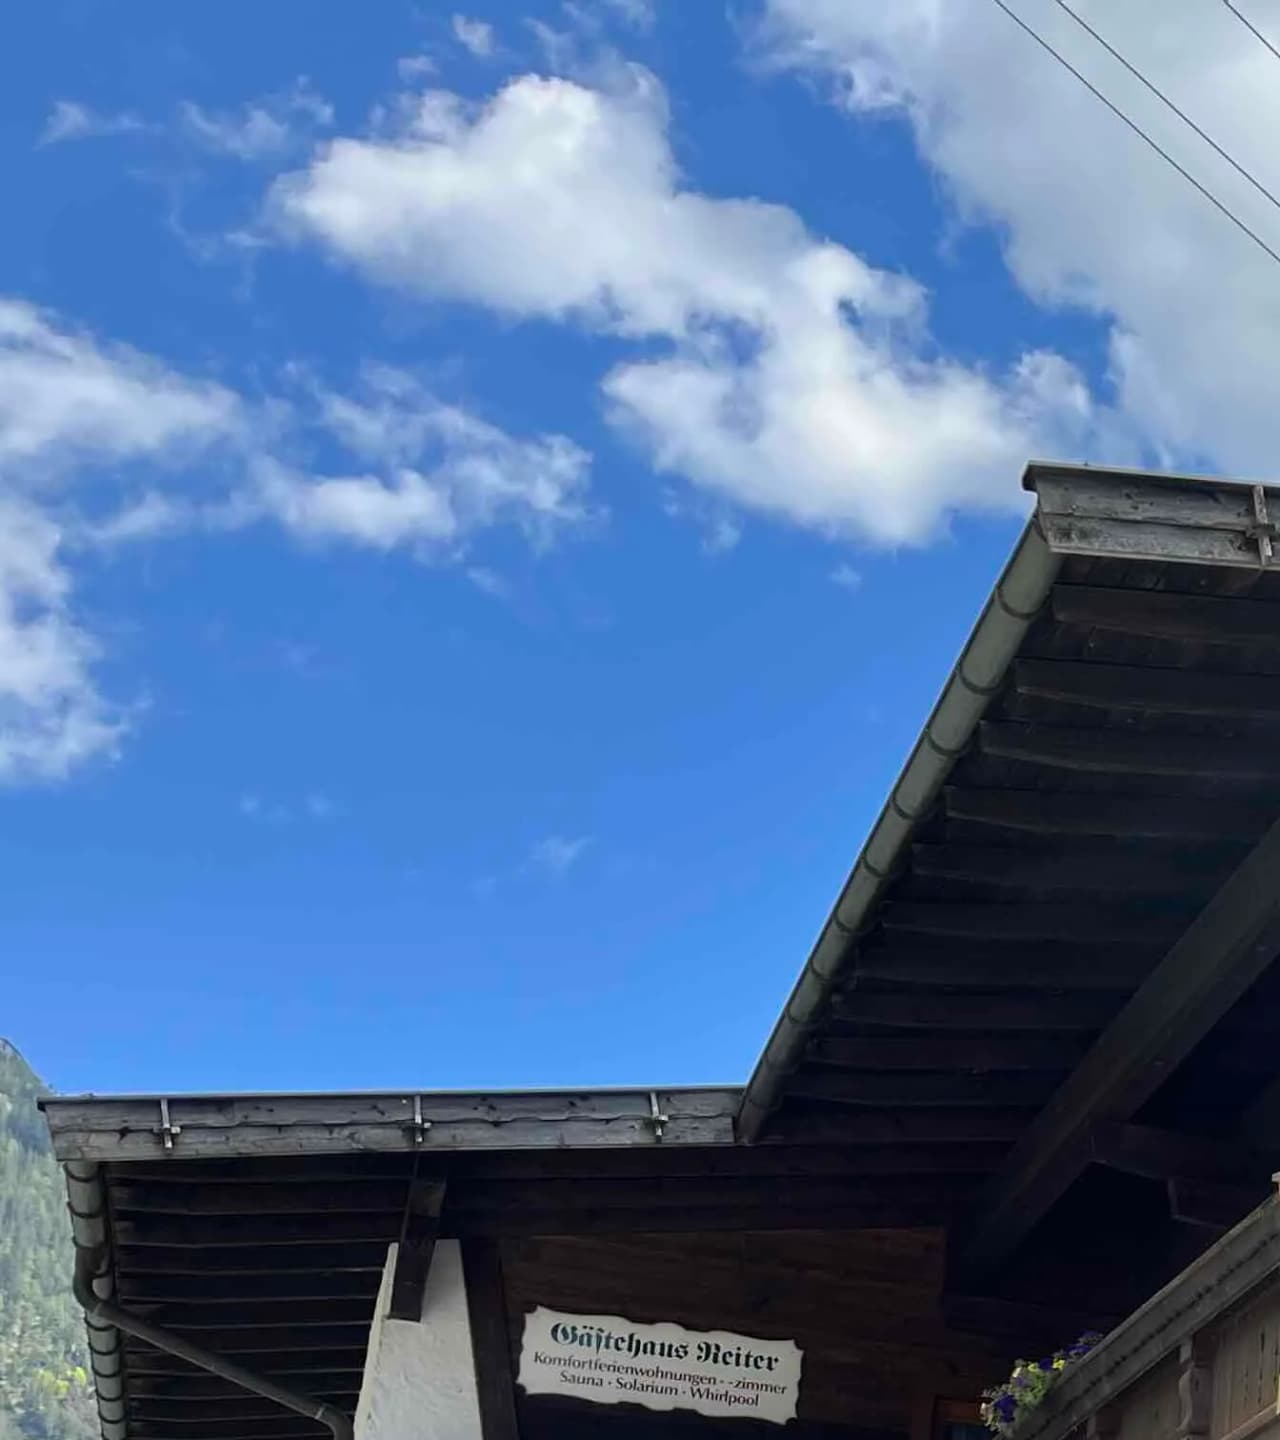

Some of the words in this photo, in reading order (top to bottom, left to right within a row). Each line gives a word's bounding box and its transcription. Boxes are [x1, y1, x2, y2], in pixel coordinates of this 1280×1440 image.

[551, 1322, 689, 1360] Gästehaus
[696, 1341, 780, 1372] Reiter
[533, 1351, 717, 1386] Komfortferienwohnungen
[559, 1369, 604, 1388] Sauna
[615, 1376, 679, 1396] Solarium
[689, 1385, 760, 1407] Whirlpool
